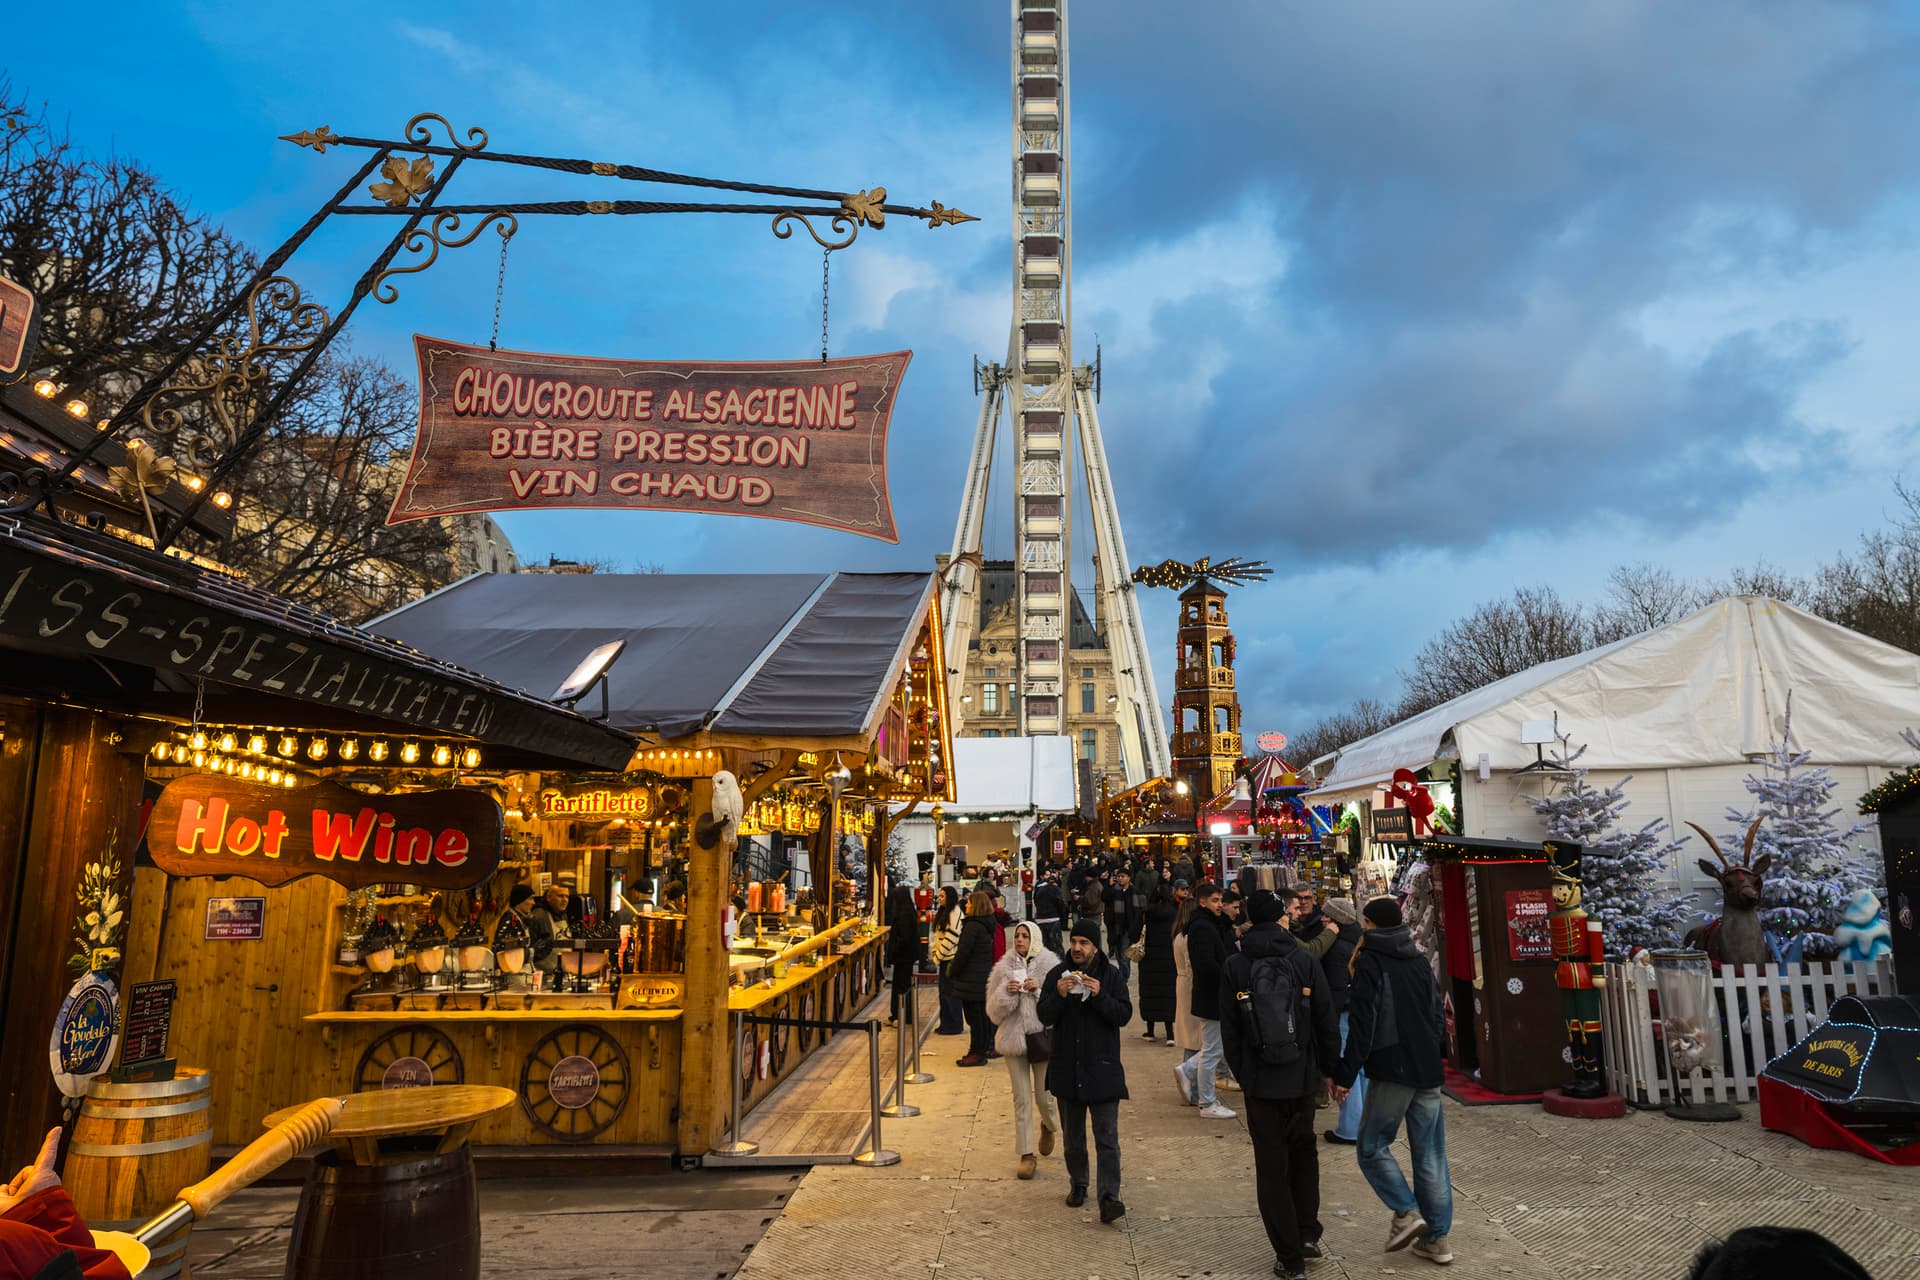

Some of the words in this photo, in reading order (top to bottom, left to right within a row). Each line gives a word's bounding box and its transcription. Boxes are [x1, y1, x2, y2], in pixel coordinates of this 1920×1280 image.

[453, 367, 654, 418] CHOUCROUTE
[663, 379, 859, 429] ALSACIENNE
[490, 420, 601, 459] BIÈRE
[613, 429, 807, 467] PRESSION
[508, 468, 598, 499] VIN
[609, 471, 773, 505] CHAUD
[541, 789, 648, 813] Tartiflette
[175, 797, 289, 858] Hot
[312, 807, 469, 866] Wine
[1803, 1060, 1817, 1071] DE
[1817, 1064, 1844, 1078] PARIS
[1808, 1039, 1843, 1054] Marrons
[1842, 1040, 1863, 1068] chauds
[400, 1070, 417, 1081] VIN
